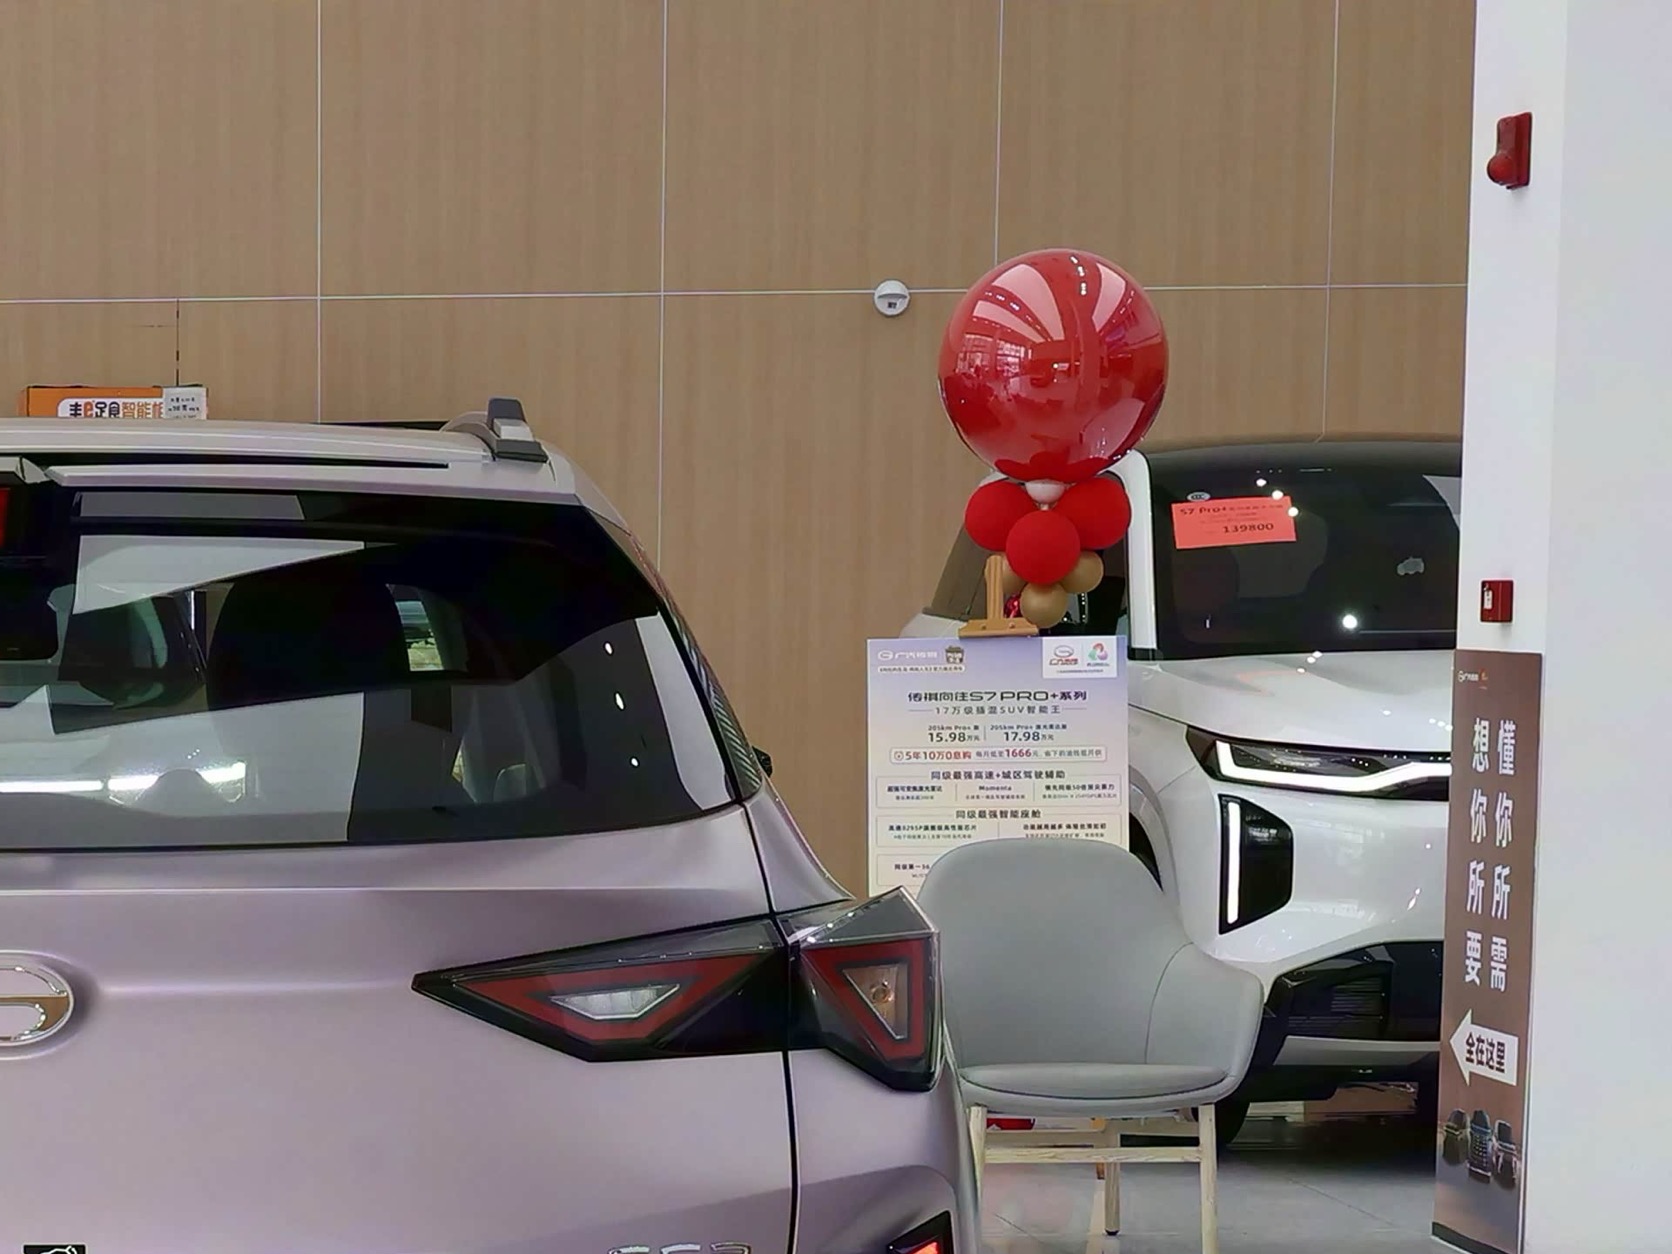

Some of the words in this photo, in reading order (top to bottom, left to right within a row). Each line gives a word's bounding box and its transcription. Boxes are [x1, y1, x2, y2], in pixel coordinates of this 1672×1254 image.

[1223, 523, 1274, 533] 139800
[1465, 718, 1490, 986] 想你所要
[1490, 719, 1516, 992] 懂你所需
[1465, 1031, 1506, 1074] 全在这里
